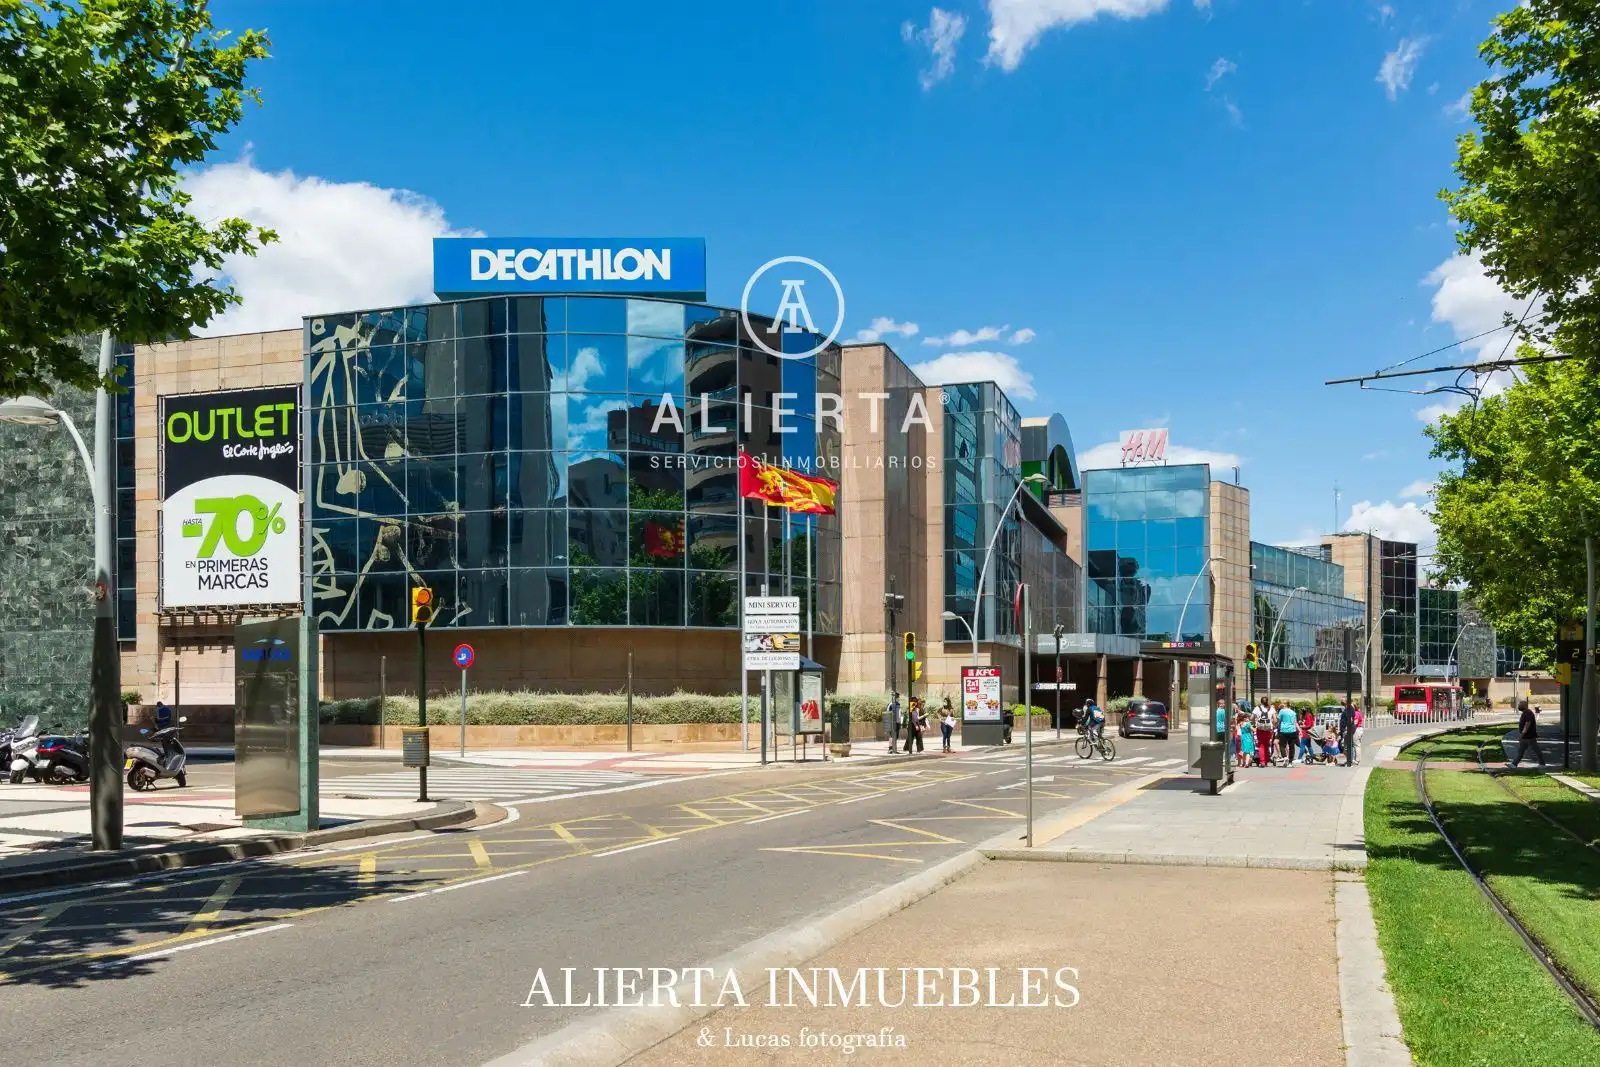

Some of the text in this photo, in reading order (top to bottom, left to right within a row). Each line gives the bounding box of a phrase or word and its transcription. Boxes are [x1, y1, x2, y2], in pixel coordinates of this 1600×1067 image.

[470, 248, 671, 281] DECATHLON
[167, 403, 295, 443] OUTLET
[223, 438, 294, 460] El Corte Inglés
[1121, 430, 1167, 462] H&M
[198, 558, 268, 573] PRIMERAS
[198, 572, 269, 590] MARCAS
[766, 601, 798, 609] SERVICE
